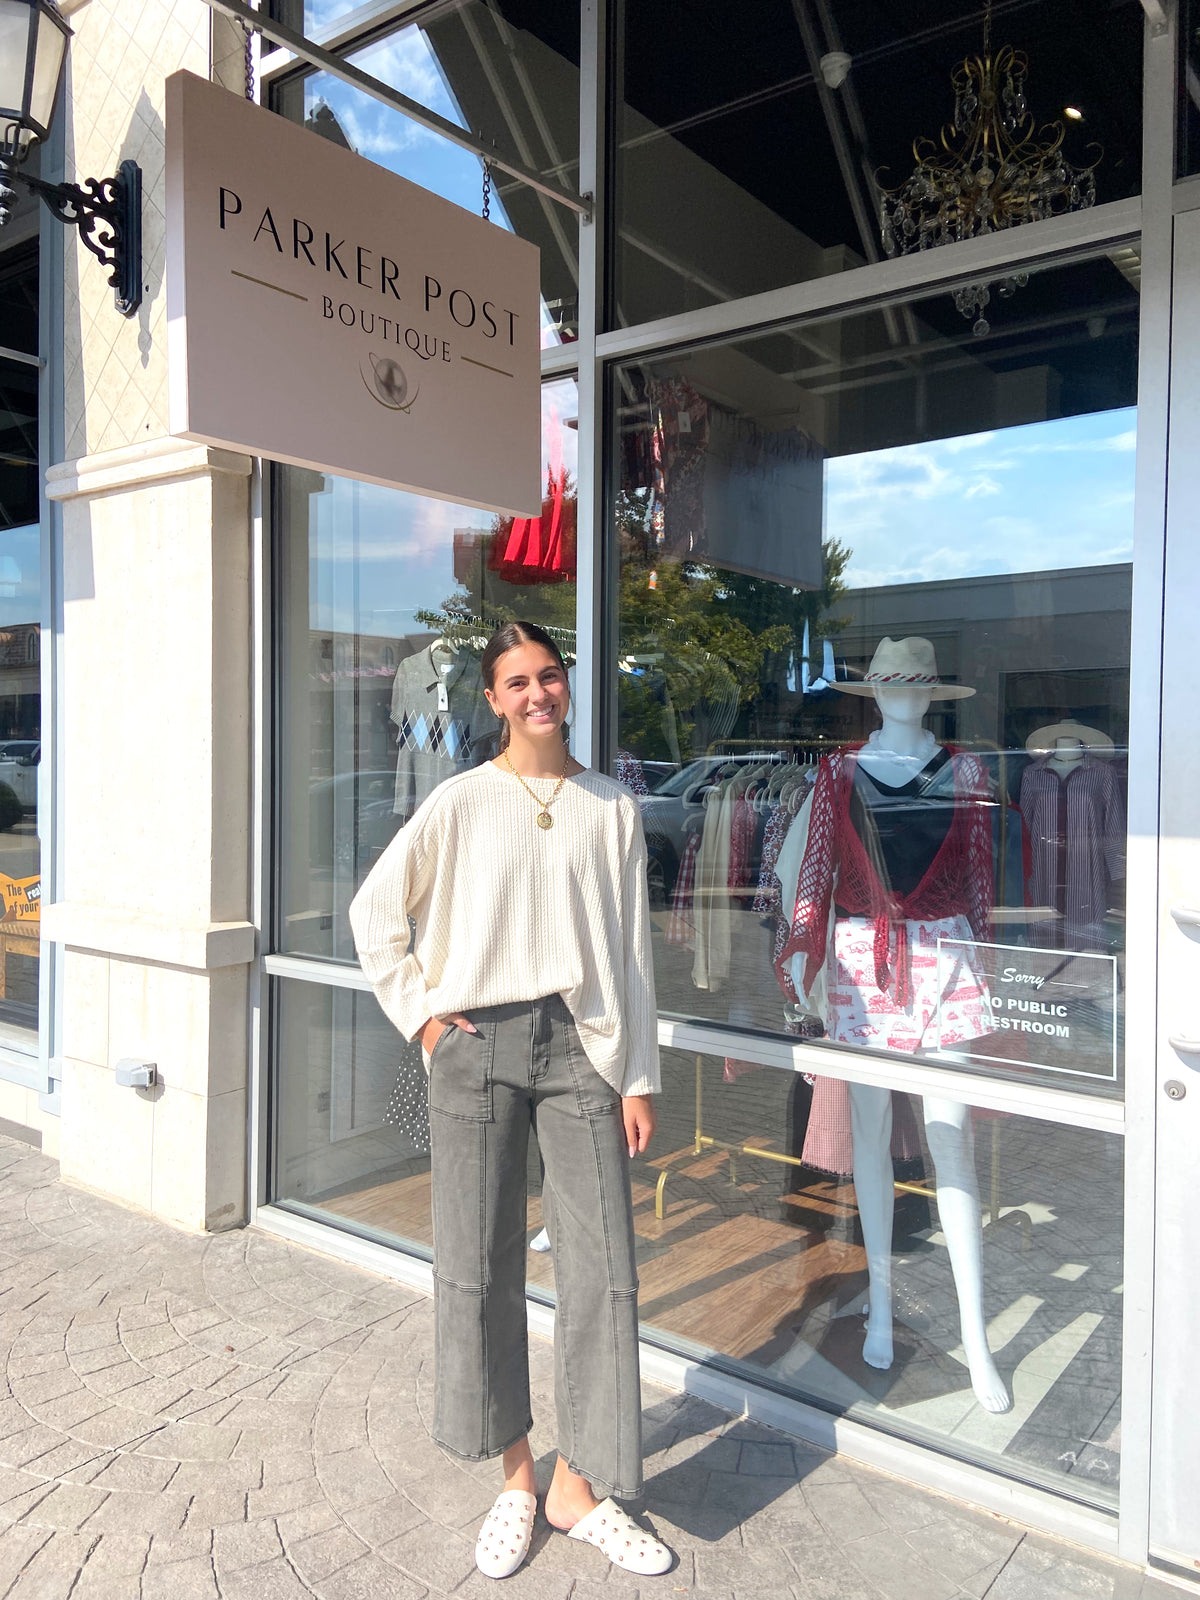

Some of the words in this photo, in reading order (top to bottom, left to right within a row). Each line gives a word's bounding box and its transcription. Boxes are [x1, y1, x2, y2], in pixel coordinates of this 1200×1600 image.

[218, 186, 402, 301] PARKER
[424, 275, 521, 346] POST
[321, 295, 452, 361] BOUTIQUE
[6, 884, 22, 896] The
[19, 903, 39, 916] your
[1000, 967, 1045, 990] Sorry
[980, 995, 1003, 1009] NO
[1007, 998, 1068, 1017] PUBLIC
[980, 1014, 1070, 1038] RESTROOM
